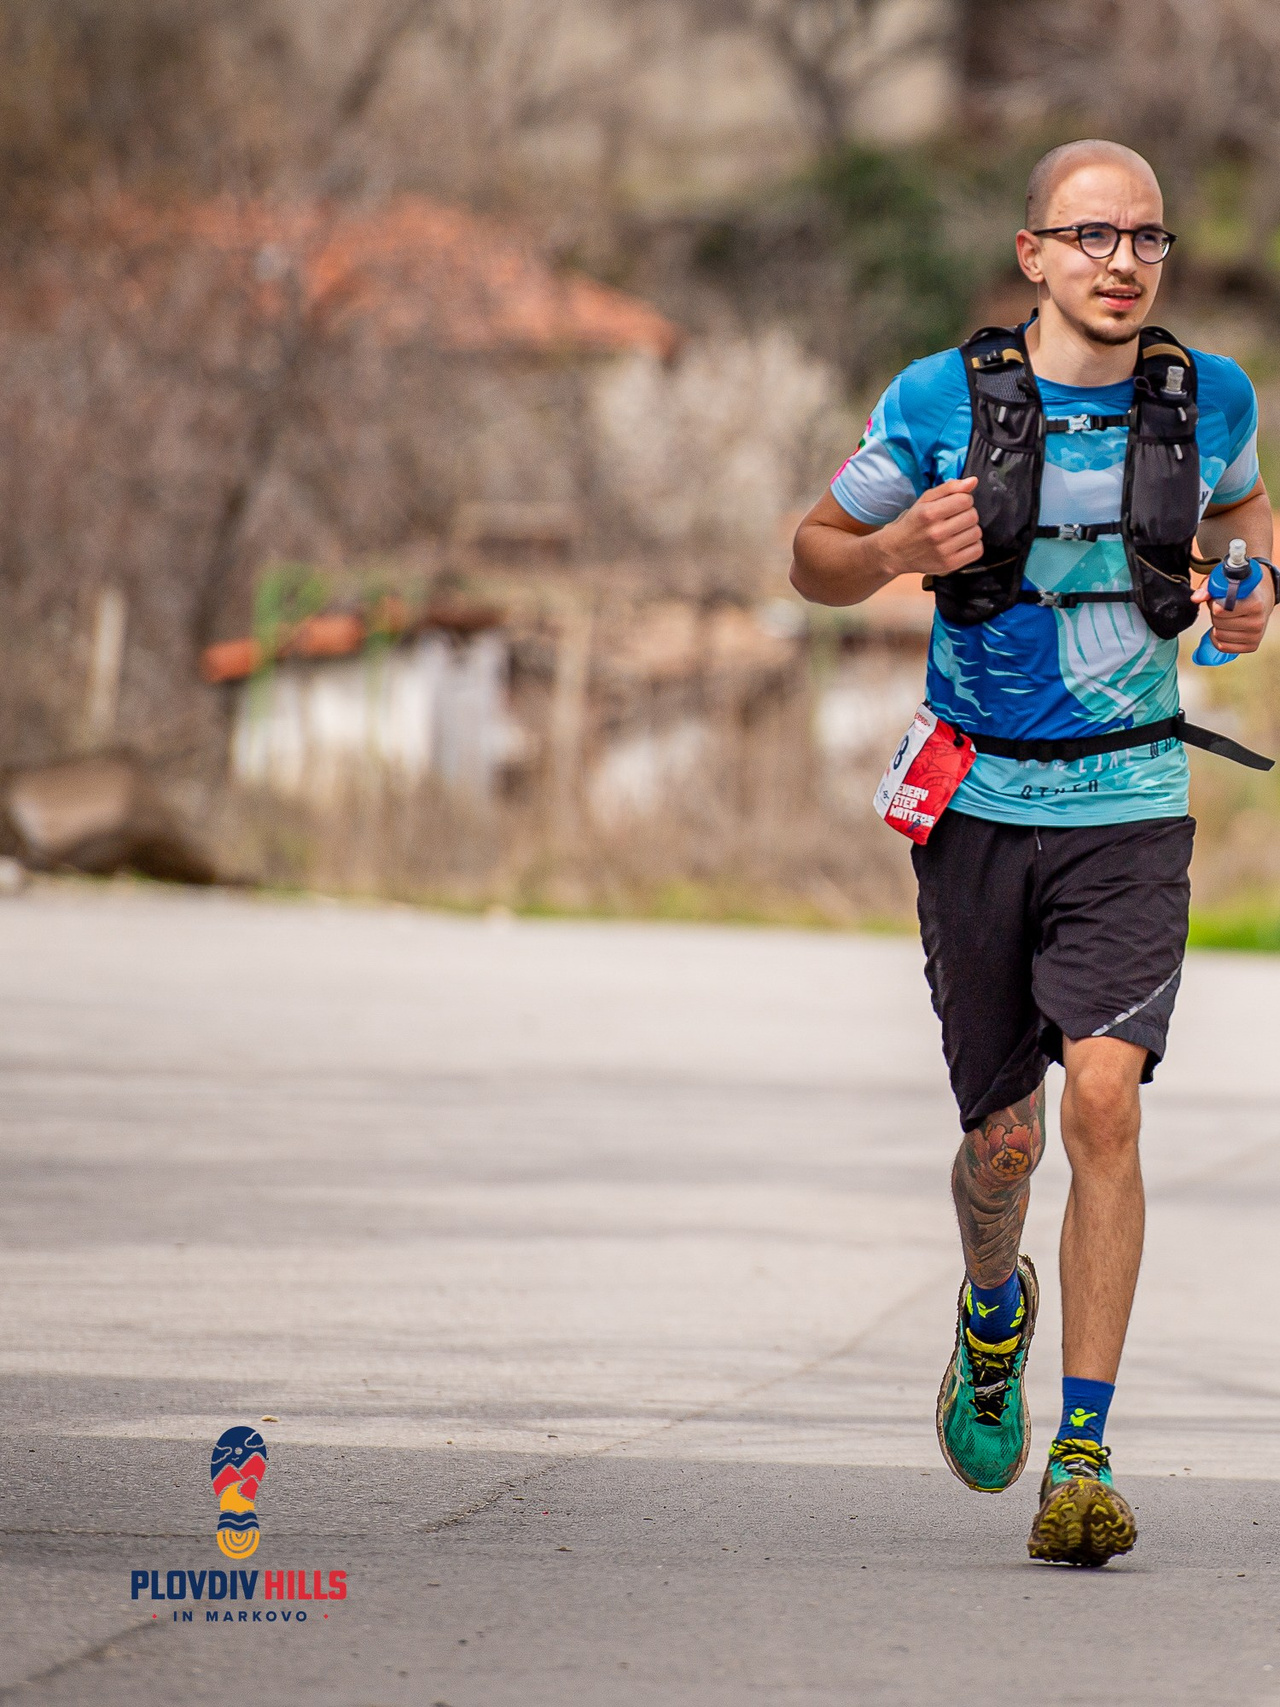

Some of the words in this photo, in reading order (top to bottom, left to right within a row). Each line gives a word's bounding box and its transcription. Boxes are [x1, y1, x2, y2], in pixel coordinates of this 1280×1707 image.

[892, 793, 918, 809] STEP
[898, 783, 929, 801] EVERY
[889, 805, 935, 827] MATTERS
